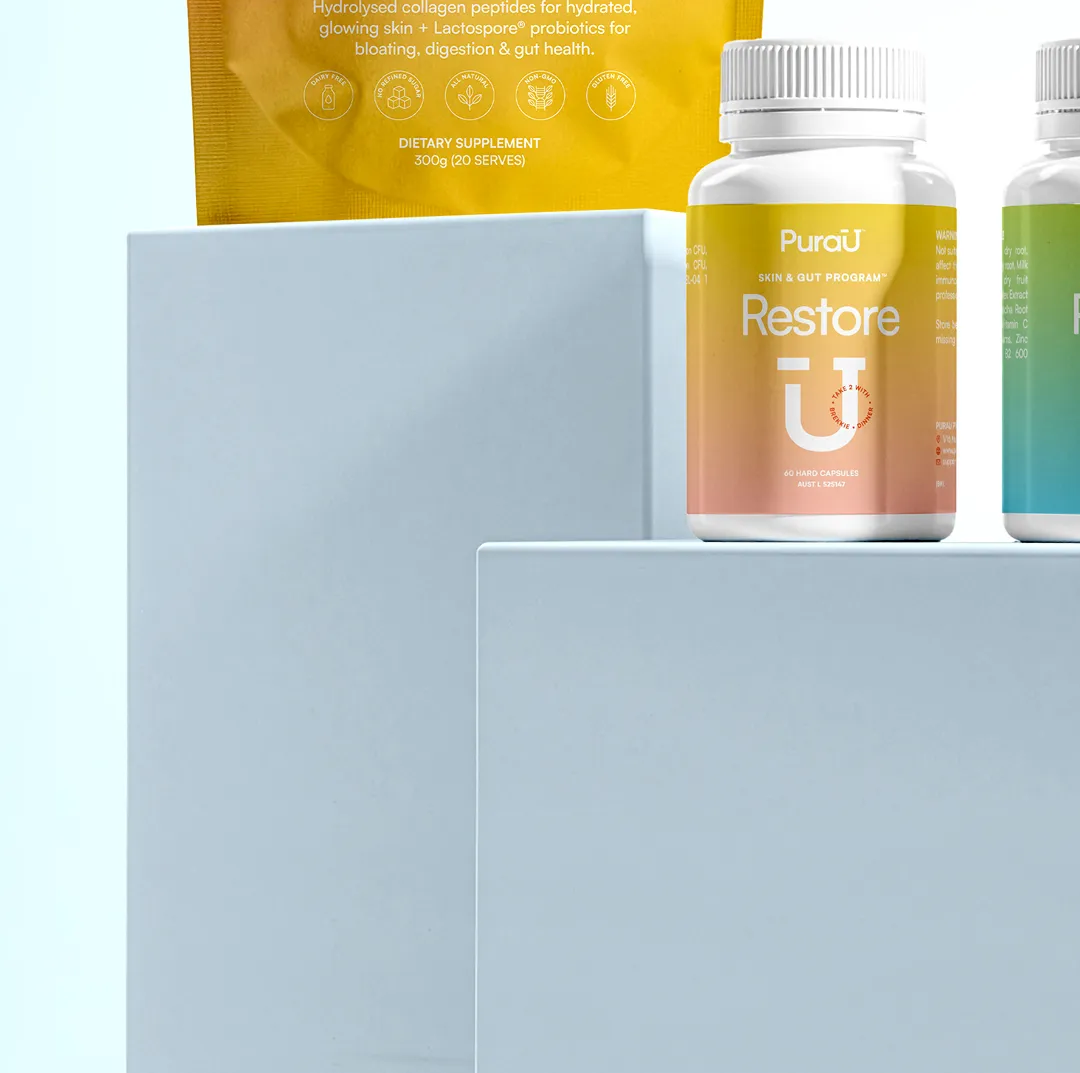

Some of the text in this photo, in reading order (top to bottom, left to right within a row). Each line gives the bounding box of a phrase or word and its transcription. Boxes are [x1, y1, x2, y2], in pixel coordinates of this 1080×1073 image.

[312, 0, 638, 18] Hydrolysed collagen peptides for hydrated,
[319, 19, 380, 39] glowing
[383, 20, 414, 35] skin
[418, 22, 429, 33] +
[529, 20, 606, 39] probiotics
[609, 20, 631, 35] for
[354, 41, 595, 60] bloating, digestion & gut health.
[310, 74, 346, 86] DAIRY FREE
[381, 73, 408, 88] REFINED
[407, 77, 421, 98] SUGAR
[450, 73, 490, 89] ALL NATURAL
[524, 73, 557, 85] NON-GMO
[591, 73, 631, 89] GLUTEN FREE
[398, 137, 542, 149] DIETARY SUPPLEMENT
[414, 153, 526, 169] 300g (20 SERVES)
[758, 272, 783, 283] SKIN
[785, 272, 794, 283] &
[796, 272, 822, 283] GUT
[743, 294, 900, 336] Restore
[783, 469, 860, 477] 60 HARD CAPSULES
[797, 480, 817, 488] AUST
